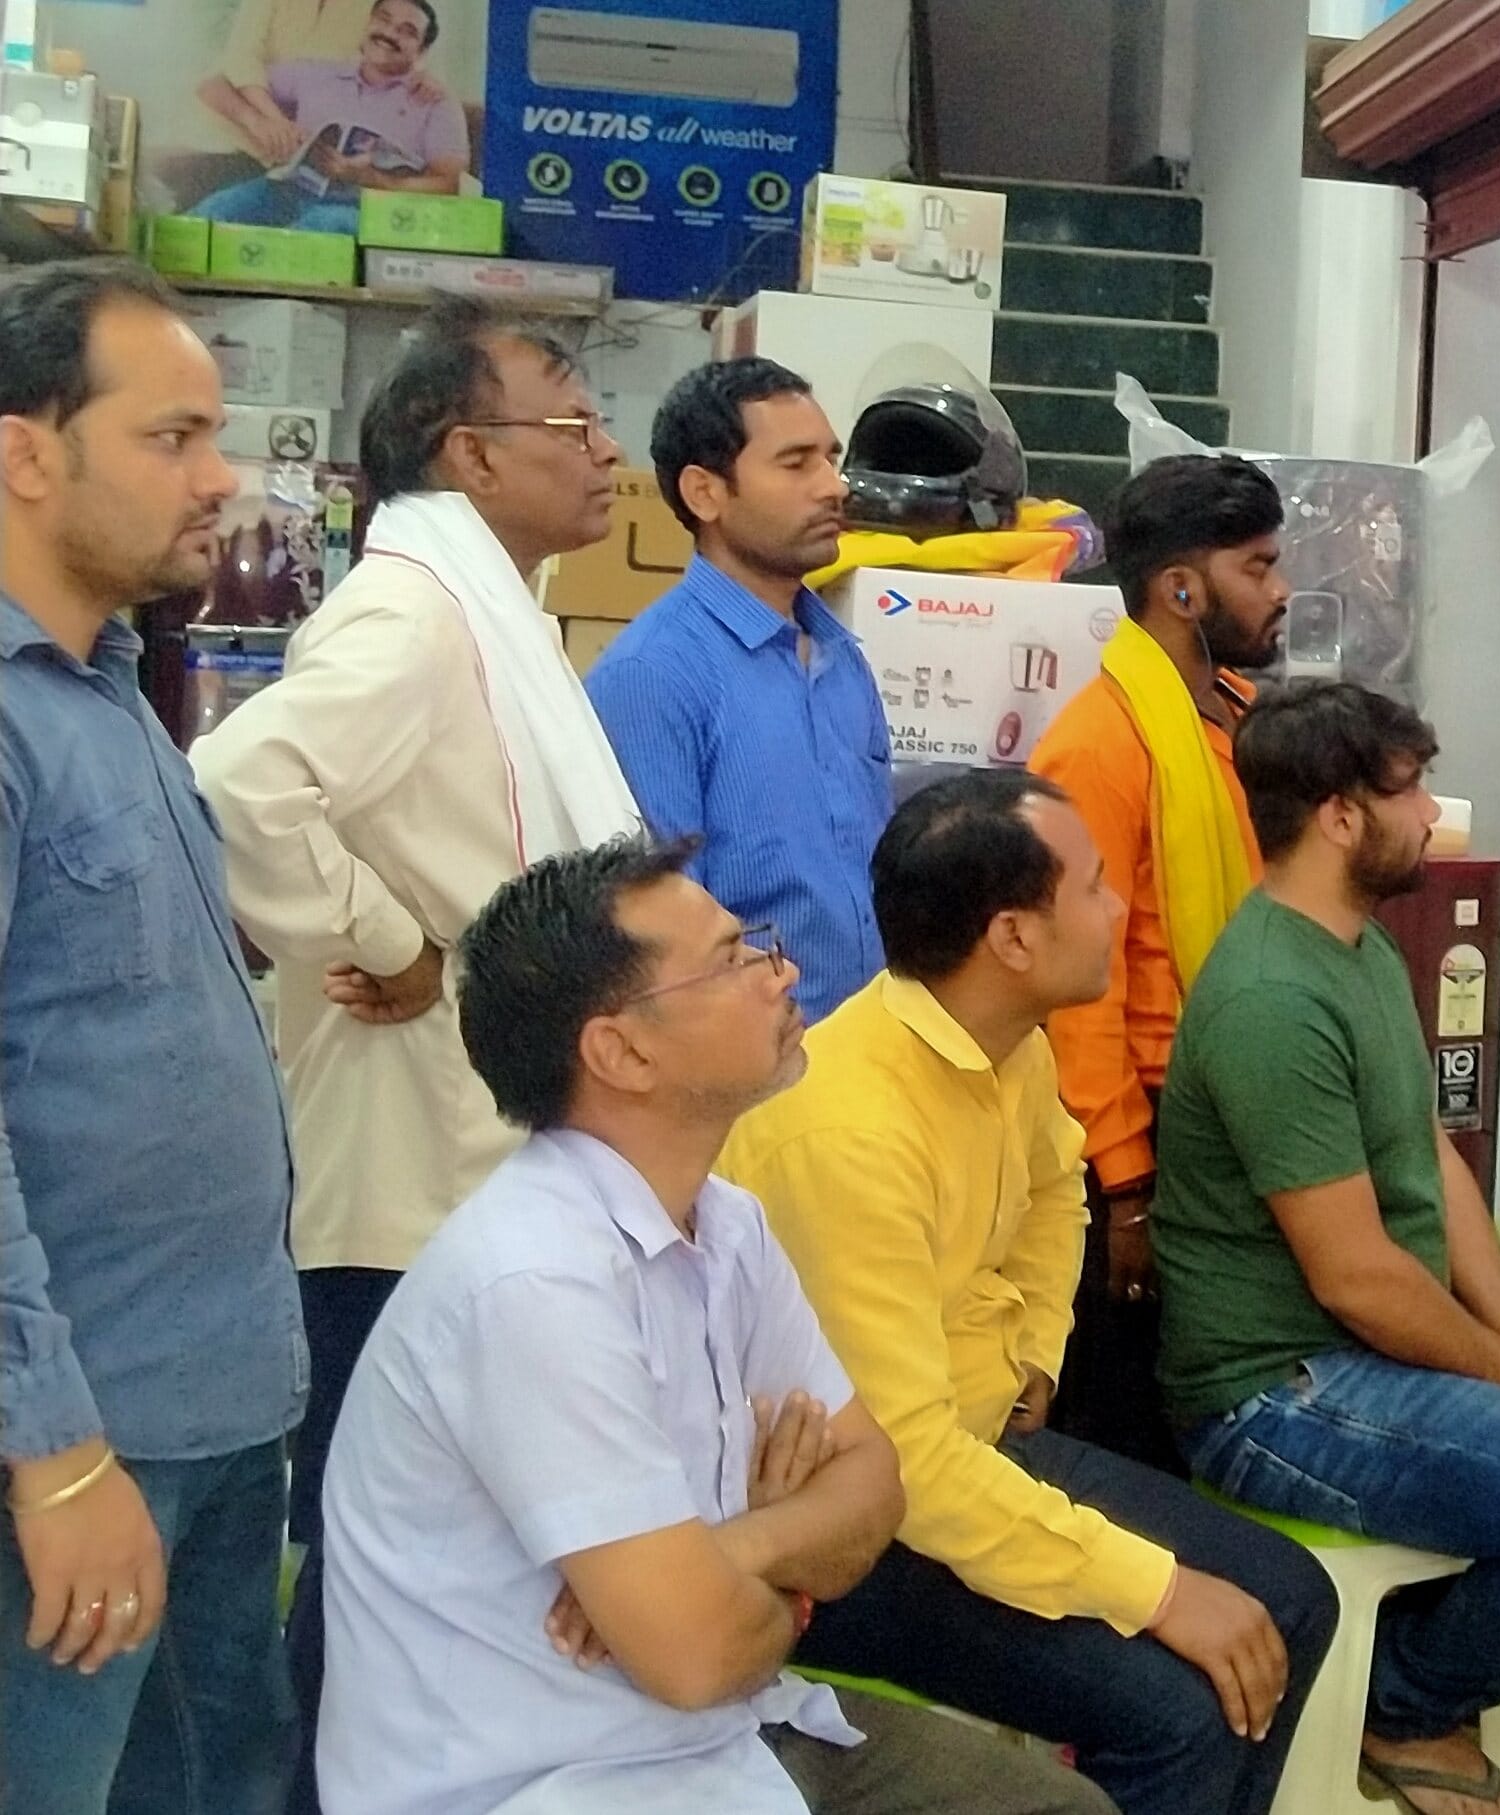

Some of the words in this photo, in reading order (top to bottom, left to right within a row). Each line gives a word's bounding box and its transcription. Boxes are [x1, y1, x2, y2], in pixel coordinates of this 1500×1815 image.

[523, 106, 653, 142] VOLTAS
[657, 117, 699, 144] all
[700, 126, 797, 153] weather
[614, 483, 640, 496] LS
[918, 598, 993, 617] BAJAJ
[888, 725, 927, 739] AJAJ
[892, 739, 945, 754] ASSIC
[950, 742, 978, 755] 750
